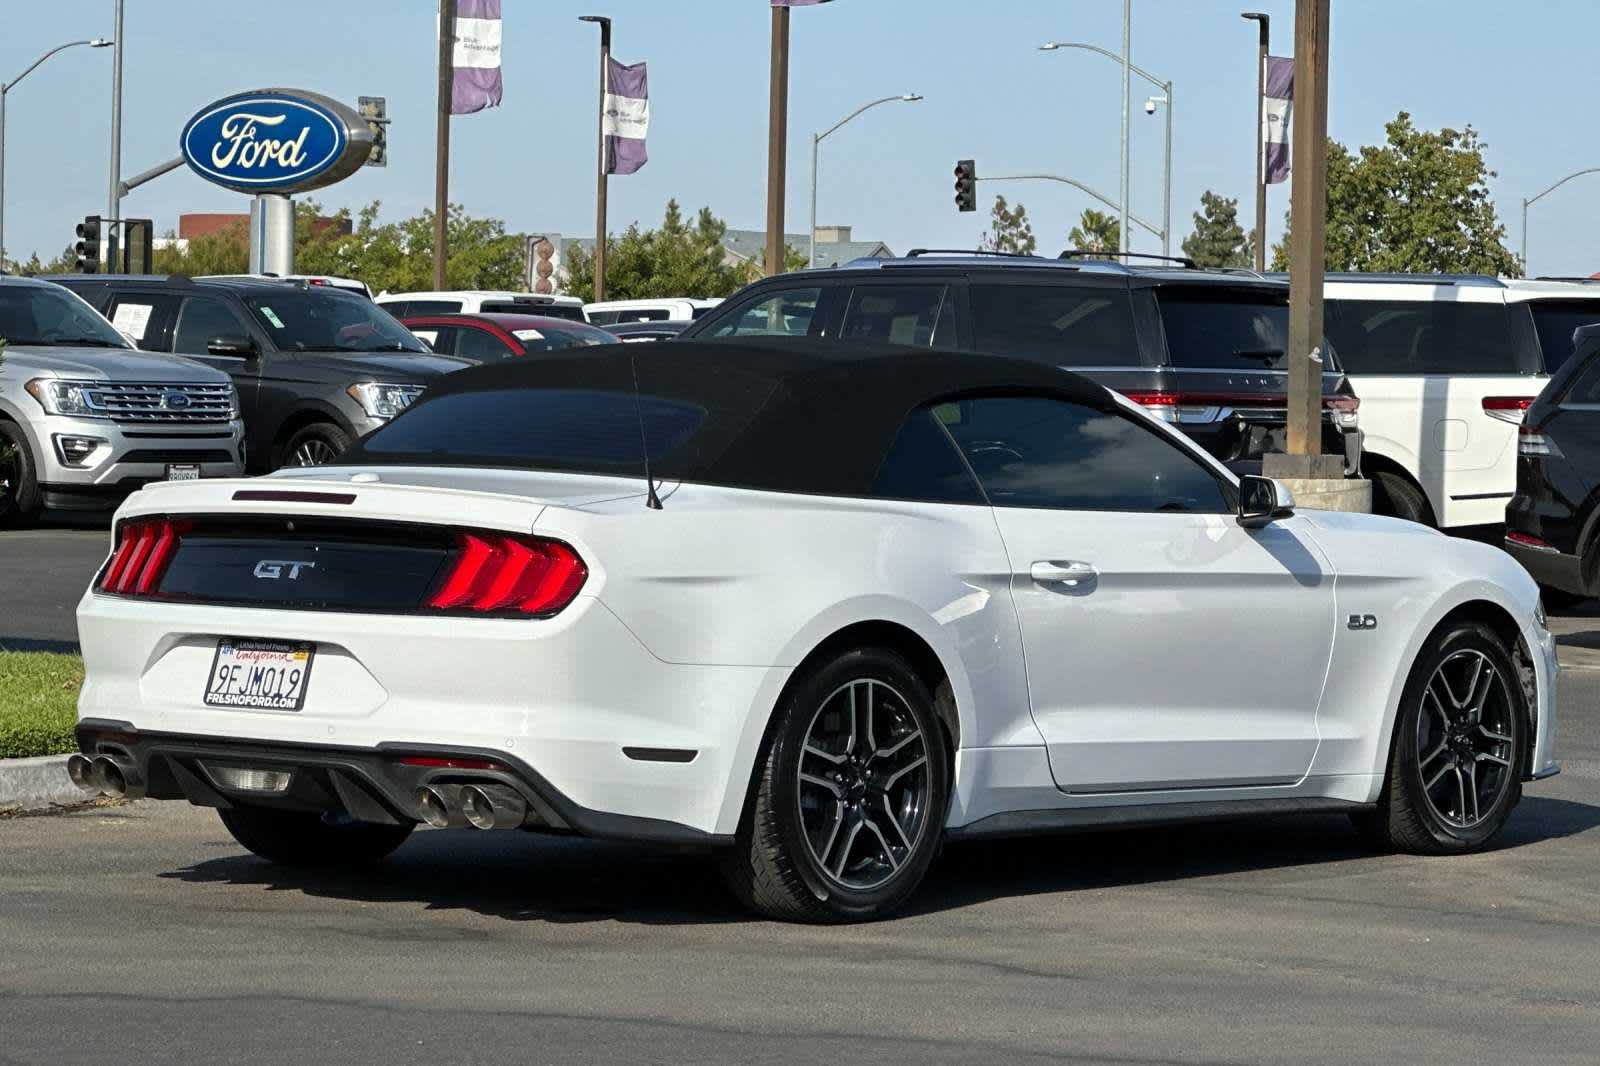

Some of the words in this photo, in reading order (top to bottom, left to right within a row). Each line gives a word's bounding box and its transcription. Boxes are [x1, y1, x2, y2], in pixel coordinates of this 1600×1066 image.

[211, 113, 310, 168] Ford
[253, 560, 315, 580] GT
[1347, 614, 1377, 630] 5.0
[236, 651, 289, 664] California
[206, 693, 297, 709] FRESNOFORD.COM
